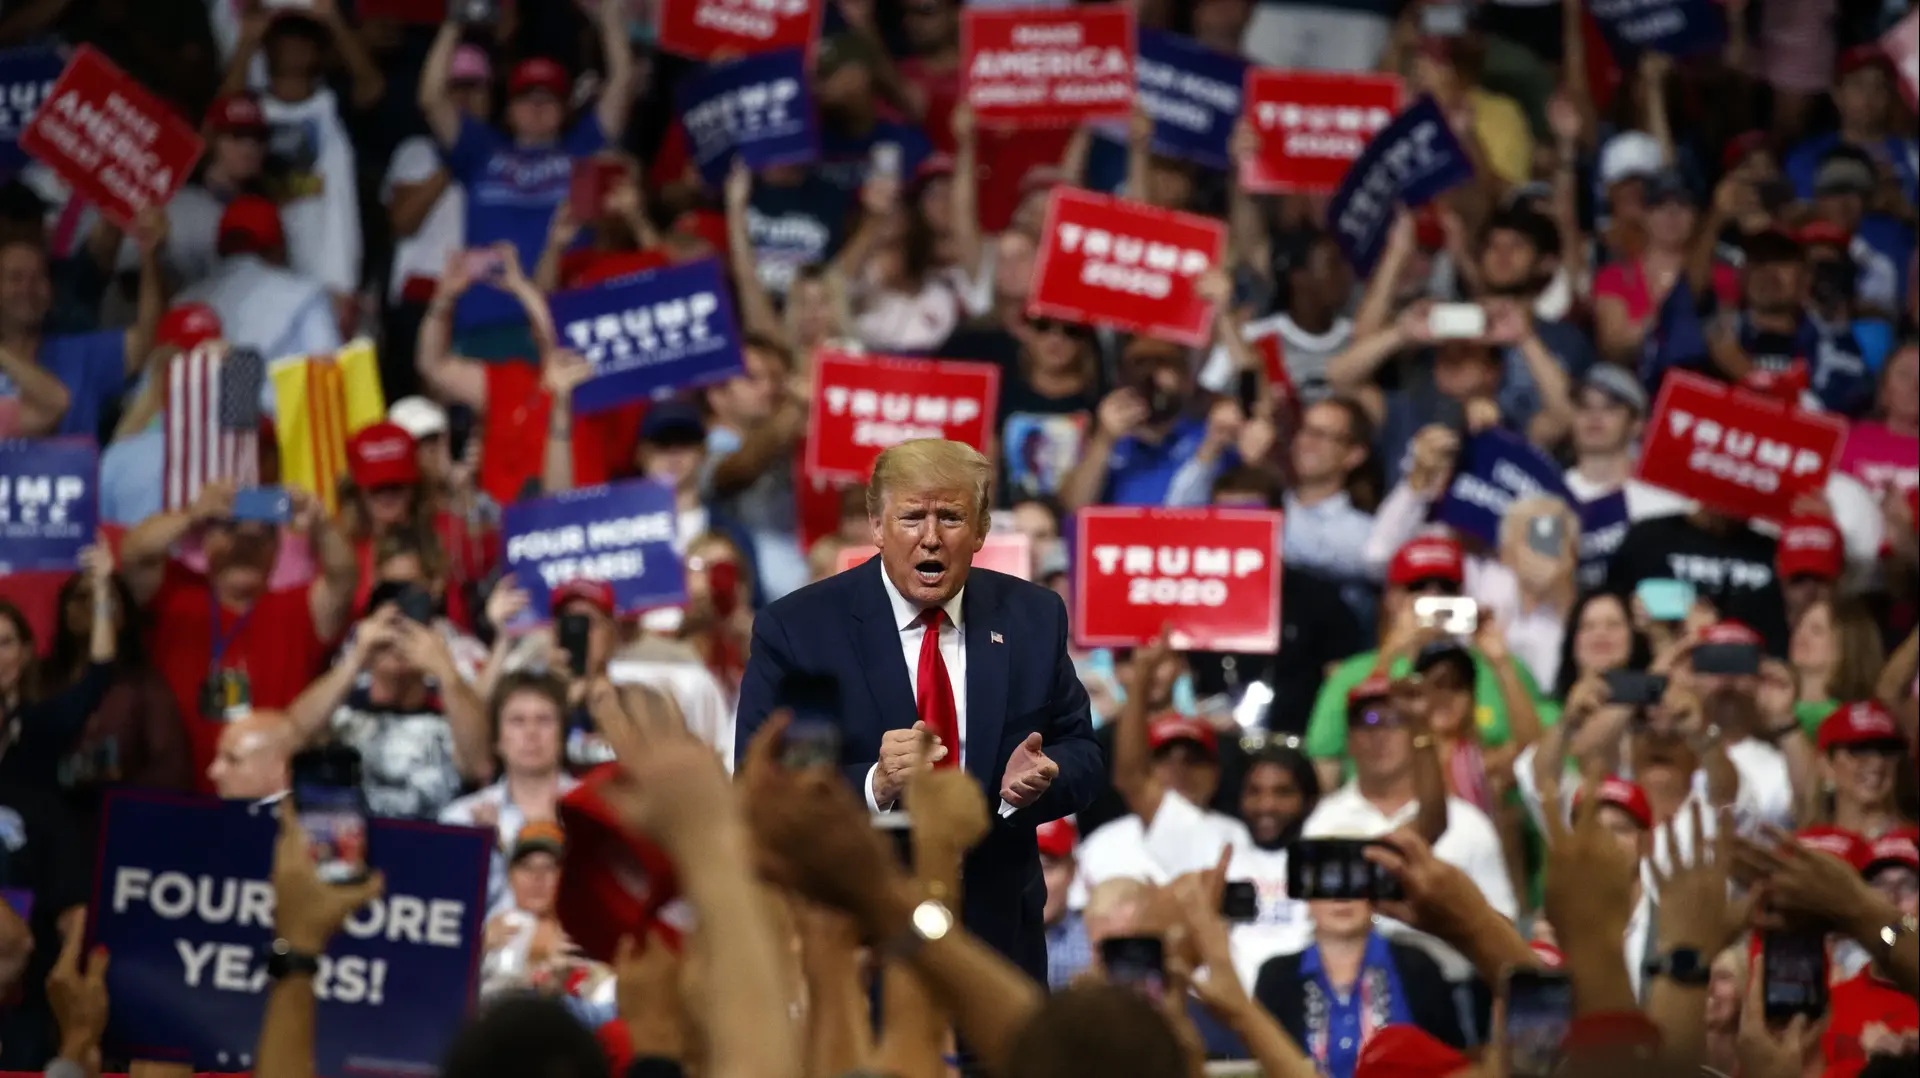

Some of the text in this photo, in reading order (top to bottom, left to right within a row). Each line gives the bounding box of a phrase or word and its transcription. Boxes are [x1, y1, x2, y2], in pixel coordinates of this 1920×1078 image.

[971, 47, 1129, 78] AMERICA
[1255, 101, 1393, 132] TRUMP
[1057, 222, 1210, 277] TRUMP
[1080, 258, 1172, 300] 2020
[564, 291, 718, 348] TRUMP
[824, 386, 981, 426] TRUMP
[1668, 409, 1822, 477] TRUMP
[1688, 449, 1780, 495] 2020
[507, 511, 674, 564] FOUR MORE
[1093, 545, 1264, 578] TRUMP
[1127, 577, 1228, 607] 2020
[113, 866, 465, 948] FOUR ORE
